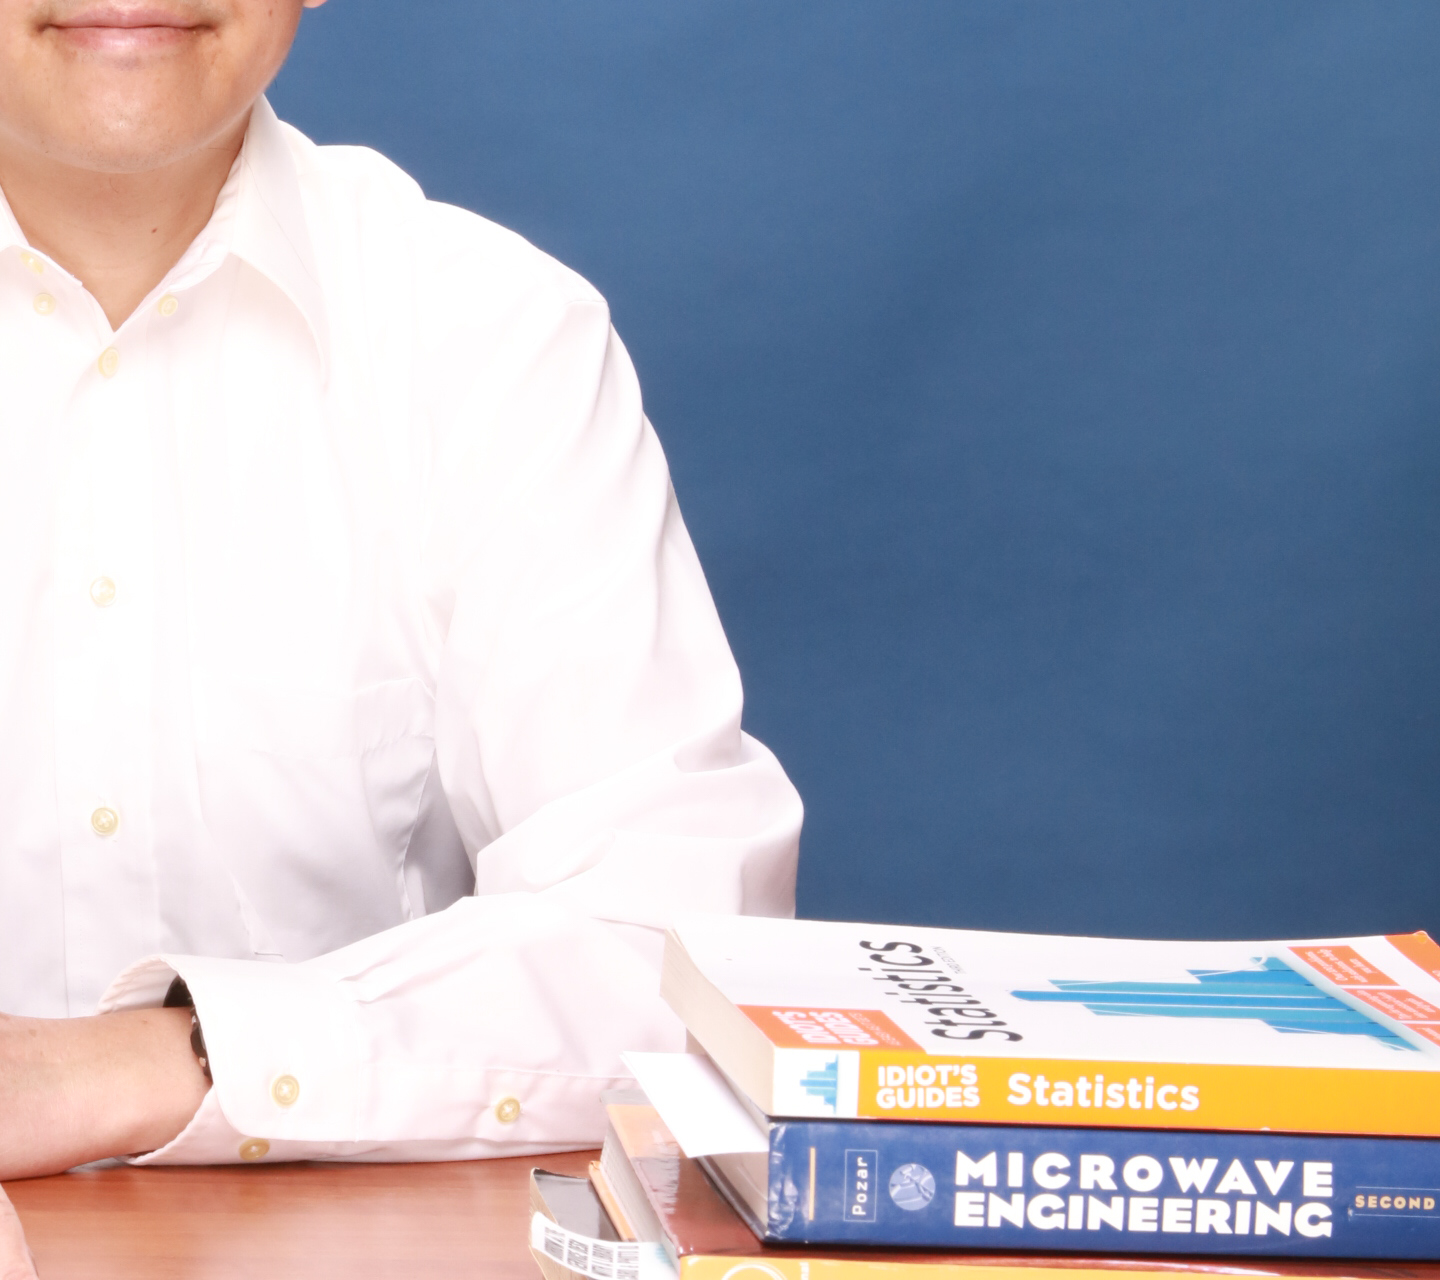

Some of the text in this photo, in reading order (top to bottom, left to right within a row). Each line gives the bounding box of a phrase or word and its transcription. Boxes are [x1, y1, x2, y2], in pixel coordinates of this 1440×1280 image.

[857, 939, 1023, 1042] Statistics
[808, 1011, 879, 1047] GUIDES
[876, 1064, 979, 1087] IDIOT'S
[1006, 1071, 1201, 1112] Statistics
[875, 1086, 981, 1109] GUIDES
[852, 1156, 868, 1216] Pozar
[955, 1150, 1333, 1198] MICROWAVE
[954, 1191, 1333, 1238] ENGINEERING
[1354, 1195, 1436, 1210] SECOND
